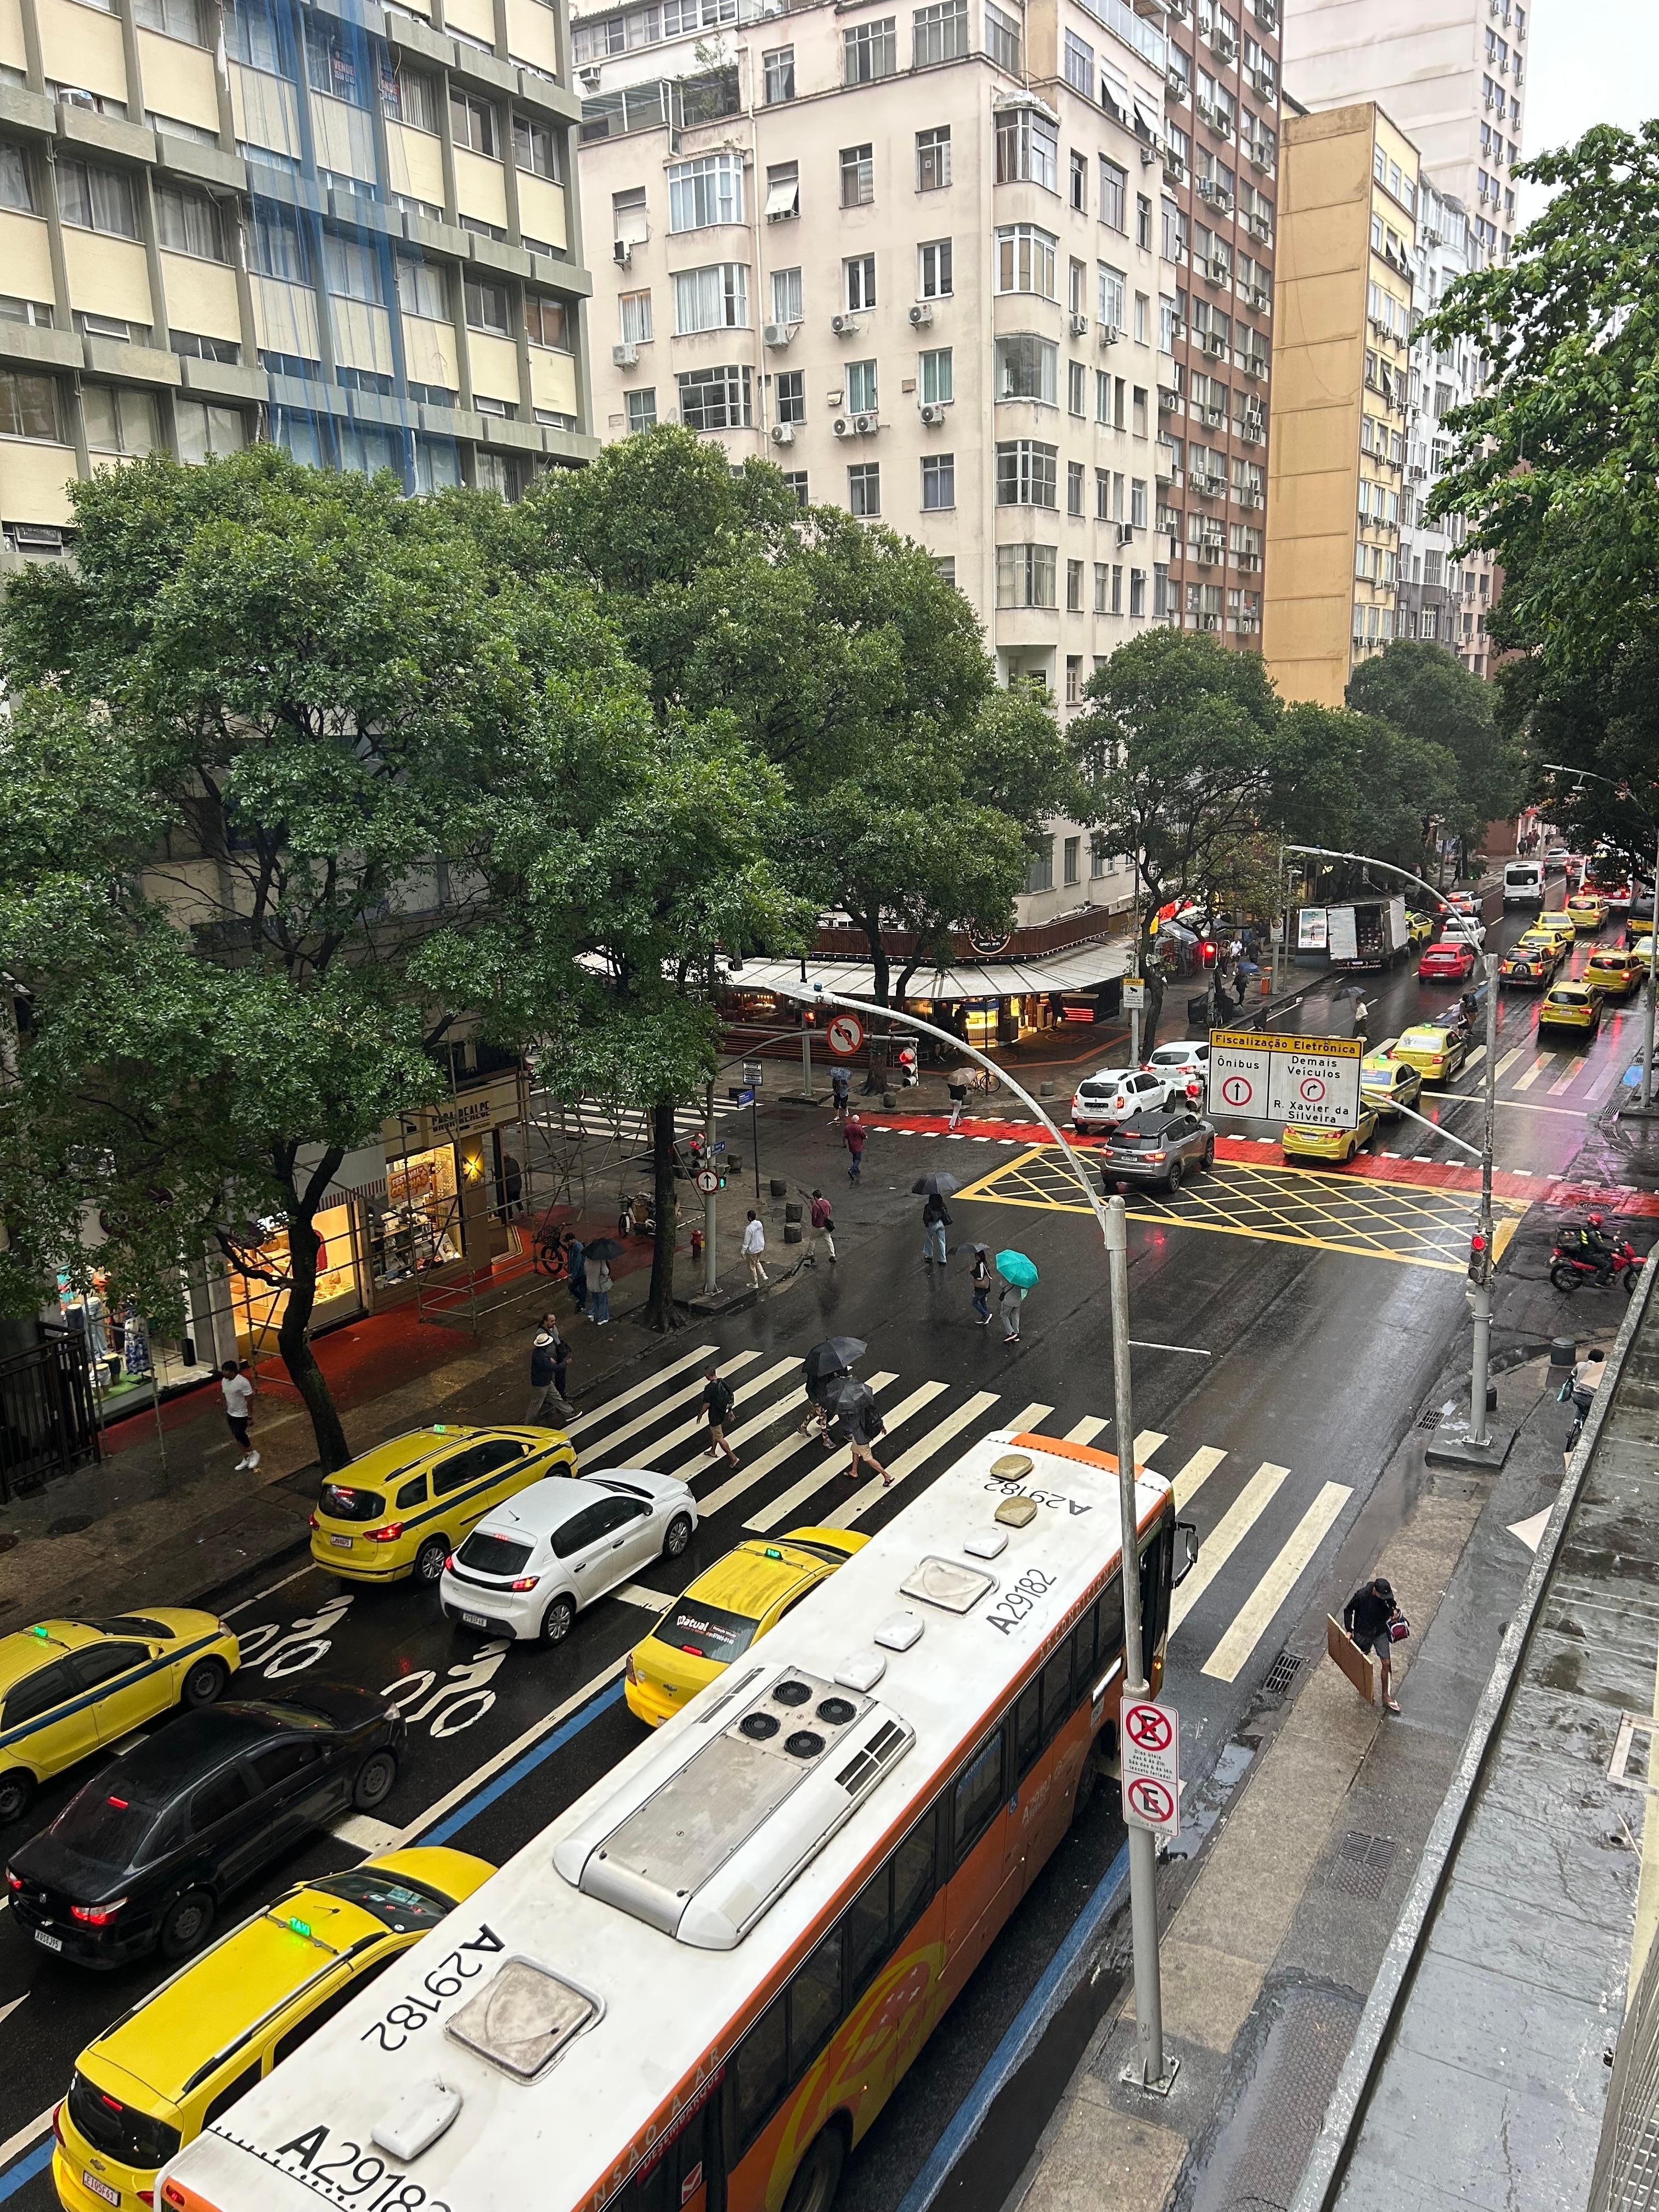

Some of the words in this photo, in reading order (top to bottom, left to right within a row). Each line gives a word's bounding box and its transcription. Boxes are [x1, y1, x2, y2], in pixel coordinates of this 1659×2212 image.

[334, 59, 354, 76] VENDE
[381, 79, 397, 95] ENDE
[1215, 1035, 1288, 1049] Fiscalização
[1294, 1041, 1356, 1054] Eletrônica
[1217, 1055, 1260, 1070] Ônibus
[1291, 1056, 1338, 1068] Demais
[1288, 1066, 1341, 1079] Veículos
[1274, 1099, 1284, 1109] R.
[1290, 1101, 1330, 1114] Xavier
[1335, 1105, 1350, 1115] da
[1288, 1111, 1336, 1124] Silveira
[391, 1170, 428, 1198] COLHAS
[392, 1167, 422, 1186] FESTVAL
[986, 1568, 1057, 1635] A29182
[1040, 1638, 1051, 1661] AR
[1055, 1554, 1121, 1640] CONDICIONAD
[1150, 1770, 1171, 1779] feriado)
[1143, 1787, 1159, 1814] E
[291, 1917, 311, 1936] TAXI
[360, 1923, 505, 2051] A29182
[580, 2123, 657, 2212] NSÃO
[695, 2047, 719, 2089] AR
